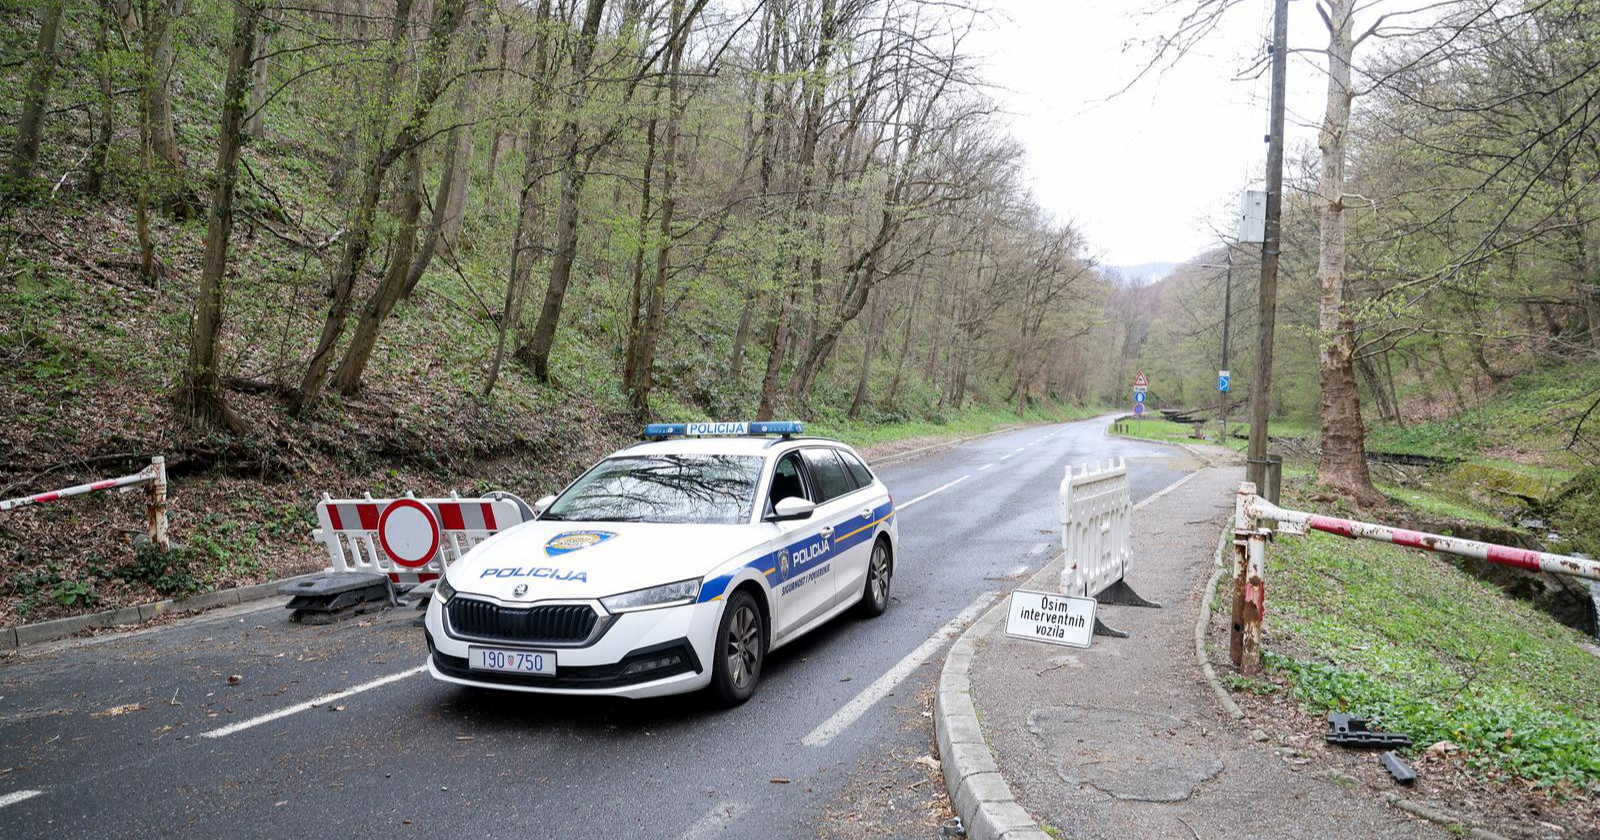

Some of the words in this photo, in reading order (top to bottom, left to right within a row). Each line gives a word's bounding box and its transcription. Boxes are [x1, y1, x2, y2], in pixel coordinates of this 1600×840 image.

[690, 424, 744, 434] POLICIJA
[793, 540, 830, 567] POLICIJA
[480, 567, 587, 583] POLICIJA
[781, 577, 805, 596] SIGURNOST
[1041, 596, 1068, 612] Osim
[1020, 607, 1085, 628] interventnih
[1036, 625, 1065, 638] vozila
[482, 651, 505, 669] 190
[516, 653, 543, 672] 750
